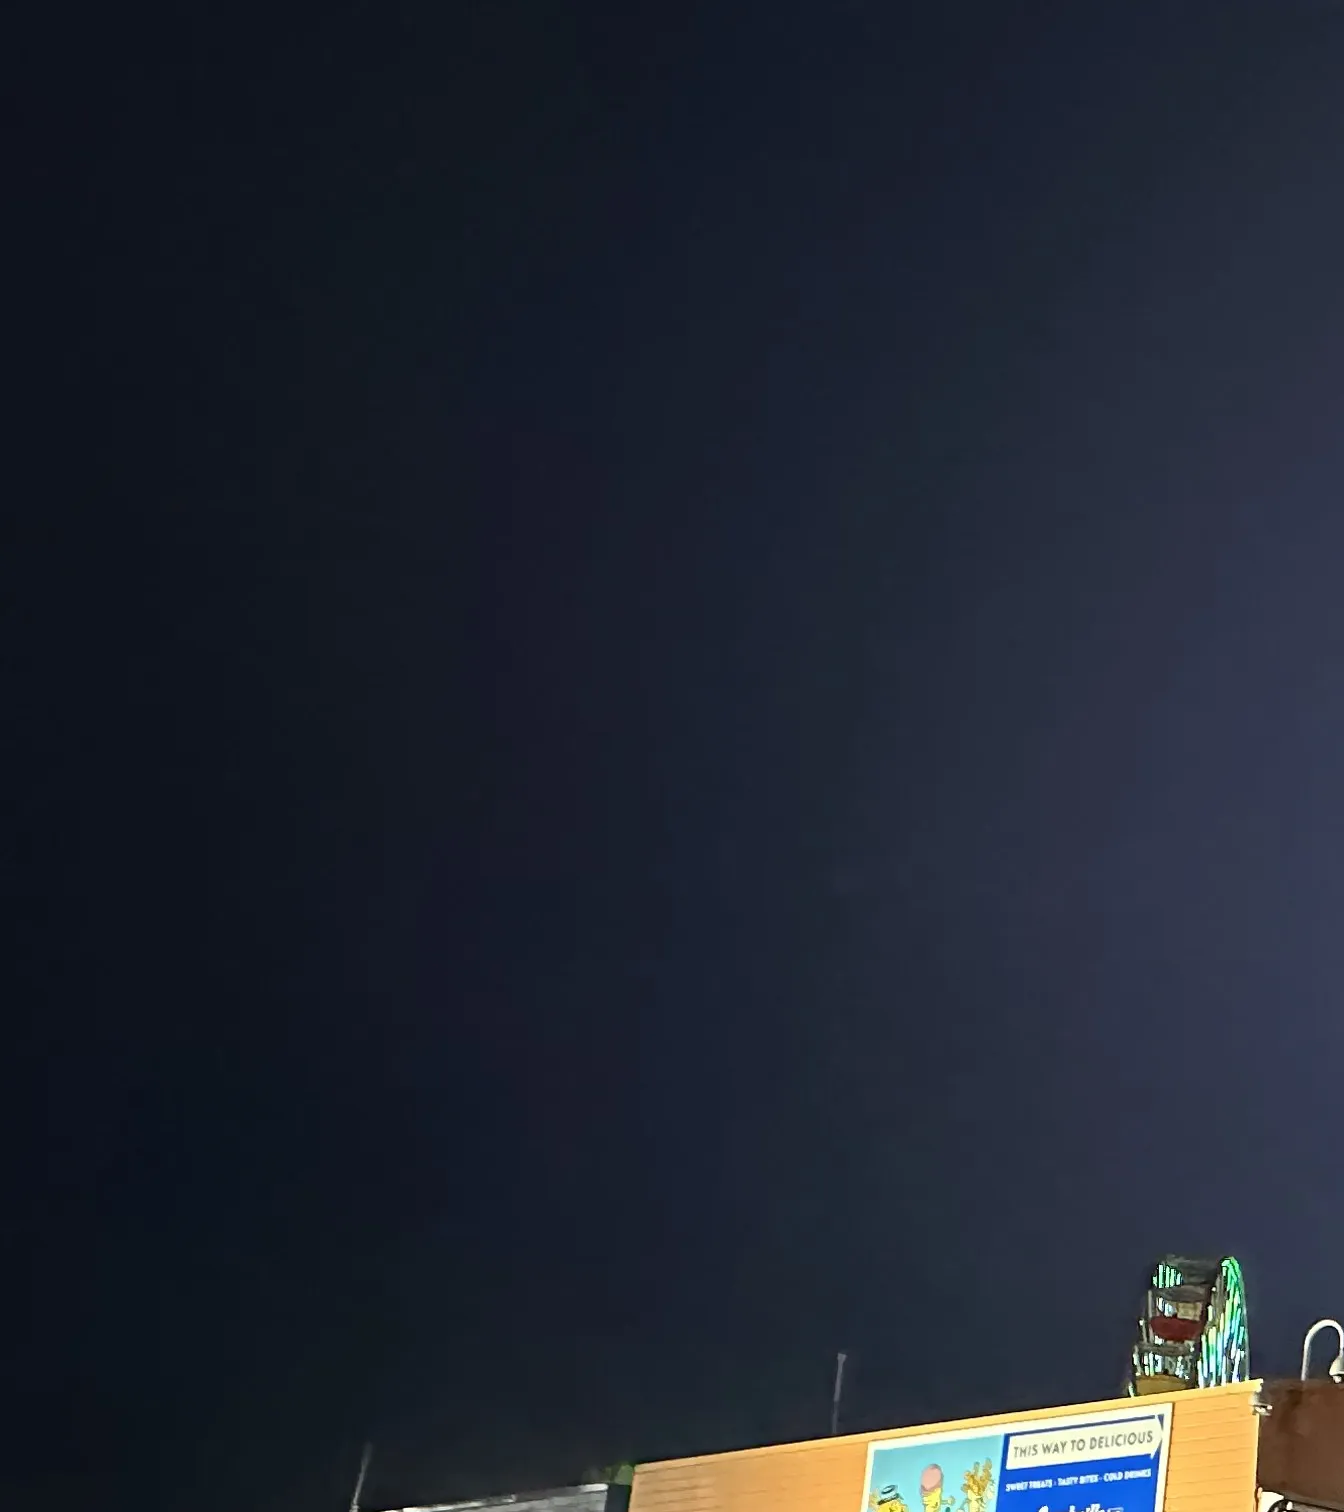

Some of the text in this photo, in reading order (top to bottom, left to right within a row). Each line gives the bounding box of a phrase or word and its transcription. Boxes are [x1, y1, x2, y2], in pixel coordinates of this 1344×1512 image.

[1013, 1430, 1154, 1459] THIS WAY TO DELICIOUS
[1005, 1481, 1028, 1492] SWEET
[1104, 1471, 1123, 1482] COLD
